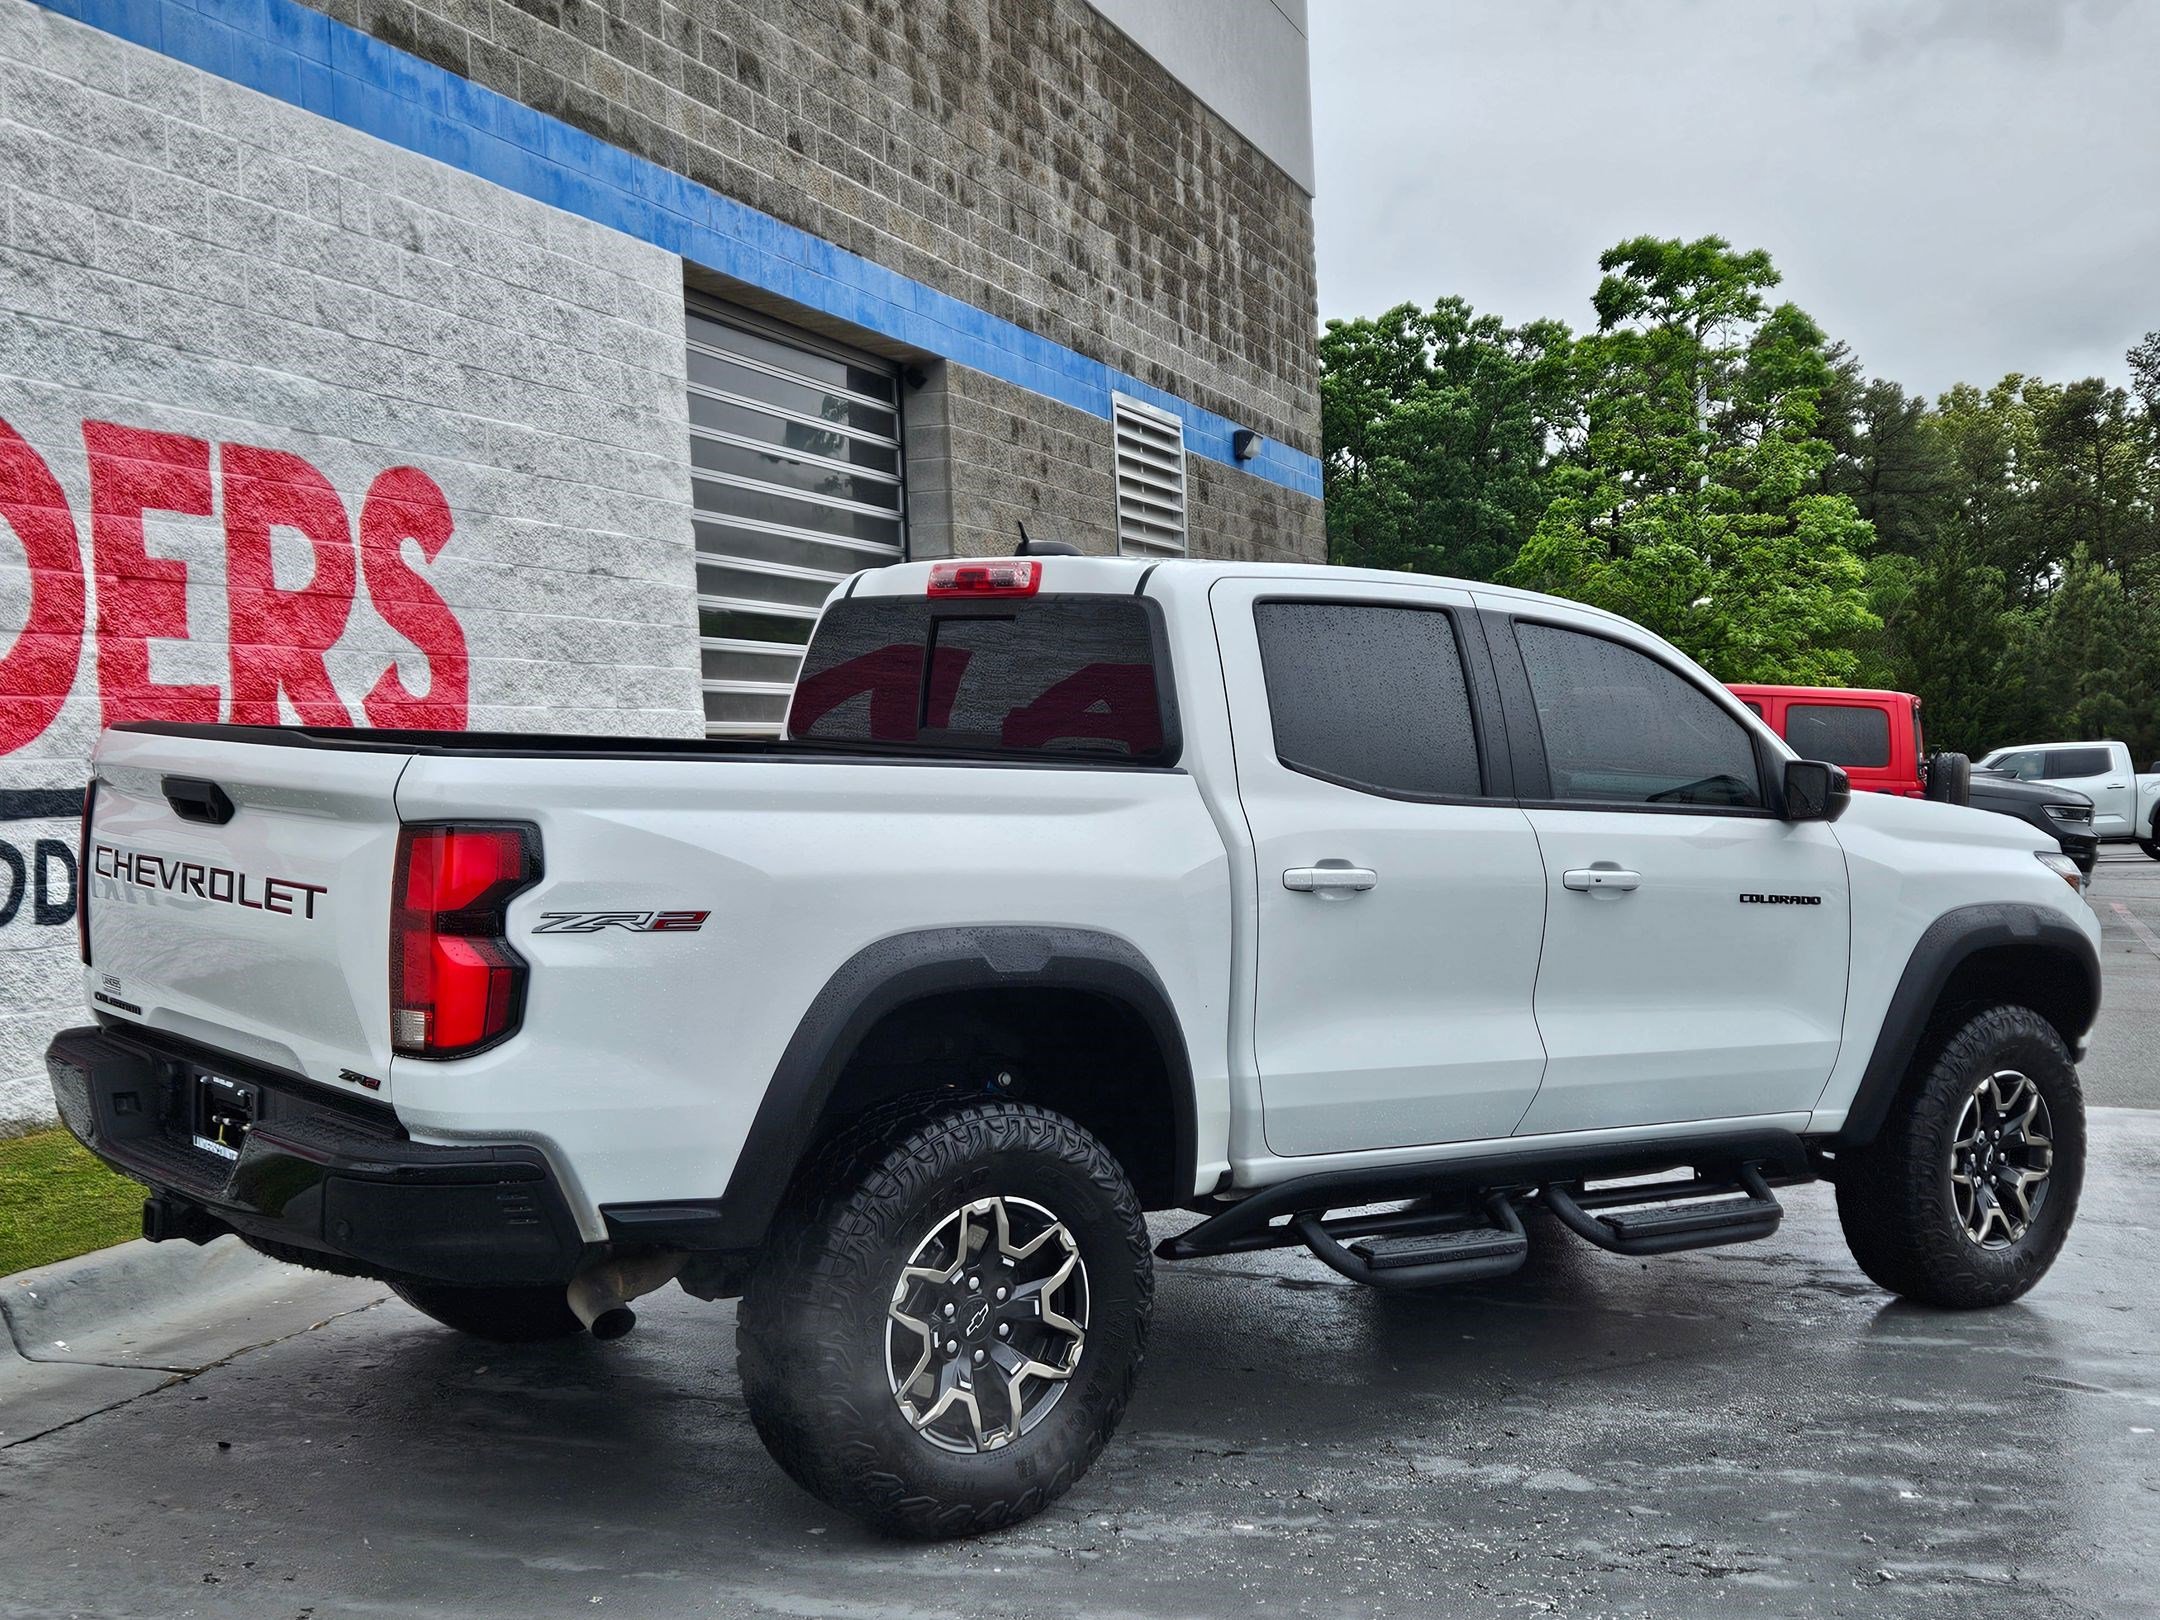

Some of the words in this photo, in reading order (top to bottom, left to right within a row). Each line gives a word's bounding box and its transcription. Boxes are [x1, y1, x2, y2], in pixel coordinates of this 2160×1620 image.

[95, 844, 328, 921] CHEVROLET
[1739, 892, 1822, 906] COLORADO
[531, 910, 712, 934] ZR2
